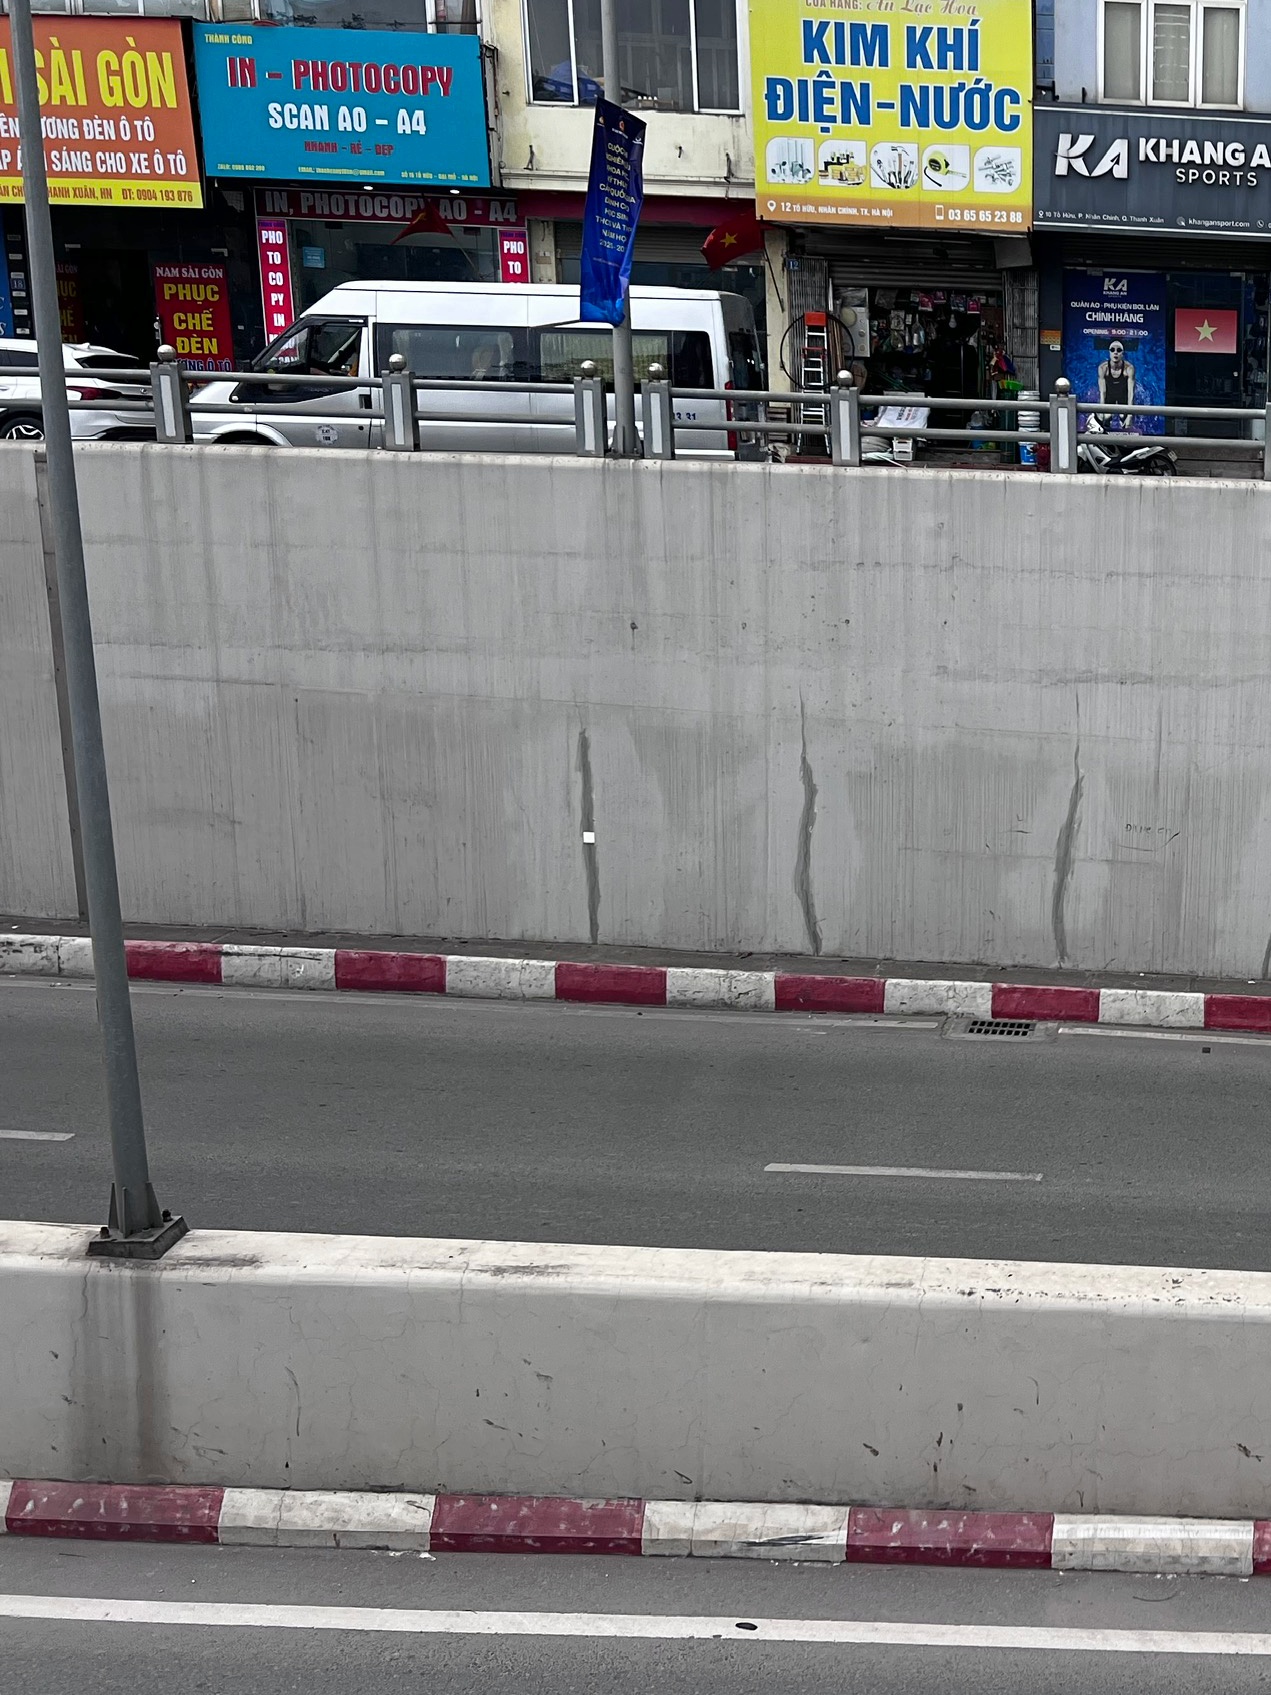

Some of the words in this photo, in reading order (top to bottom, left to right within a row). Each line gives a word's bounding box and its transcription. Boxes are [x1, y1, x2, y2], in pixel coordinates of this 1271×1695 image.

[204, 32, 230, 44] THÀNH
[231, 32, 253, 45] CÔNG
[801, 18, 890, 69] KIM
[904, 18, 981, 72] KHÍ
[96, 36, 178, 109] GÒN
[226, 56, 257, 88] IN
[291, 59, 454, 98] PHOTOCOPY
[268, 102, 330, 131] SCAN
[397, 108, 427, 135] A4
[82, 114, 116, 141] ĐÈN
[119, 115, 131, 141] Ô
[134, 116, 155, 142] TÔ
[51, 146, 92, 173] SÁNG
[95, 151, 127, 174] CHO
[129, 152, 150, 174] XE
[154, 149, 164, 175] Ô
[167, 150, 187, 176] TÔ
[1055, 133, 1129, 179] KA
[1138, 137, 1246, 167] KHANG
[1175, 168, 1258, 187] SPORTS
[72, 184, 99, 201] XUÂN,
[100, 187, 113, 200] HN
[136, 188, 157, 201] 0904
[159, 189, 175, 202] 193
[177, 190, 193, 202] 876
[264, 190, 294, 216] IN,
[489, 201, 518, 223] A4
[781, 202, 791, 212] 12
[818, 205, 836, 214] NHÂN
[948, 208, 961, 221] 03
[963, 209, 977, 222] 65
[979, 210, 992, 222] 65
[994, 210, 1007, 223] 23
[1009, 211, 1023, 223] 88
[1188, 217, 1250, 228] khangansport.com
[261, 230, 283, 244] PHO
[503, 240, 524, 255] PHO
[266, 251, 282, 265] TO
[156, 266, 179, 277] NAM
[181, 264, 199, 278] SÀI
[201, 265, 223, 279] GÒN
[507, 260, 522, 275] TO
[12, 279, 24, 289] 18
[268, 271, 283, 286] CO
[1103, 277, 1128, 292] KA
[163, 283, 220, 305] PHỤC
[270, 292, 284, 307] PY
[173, 308, 214, 331] CHẾ
[273, 313, 285, 327] IN
[1085, 310, 1115, 322] CHÍNH
[176, 334, 219, 355] ĐÈN
